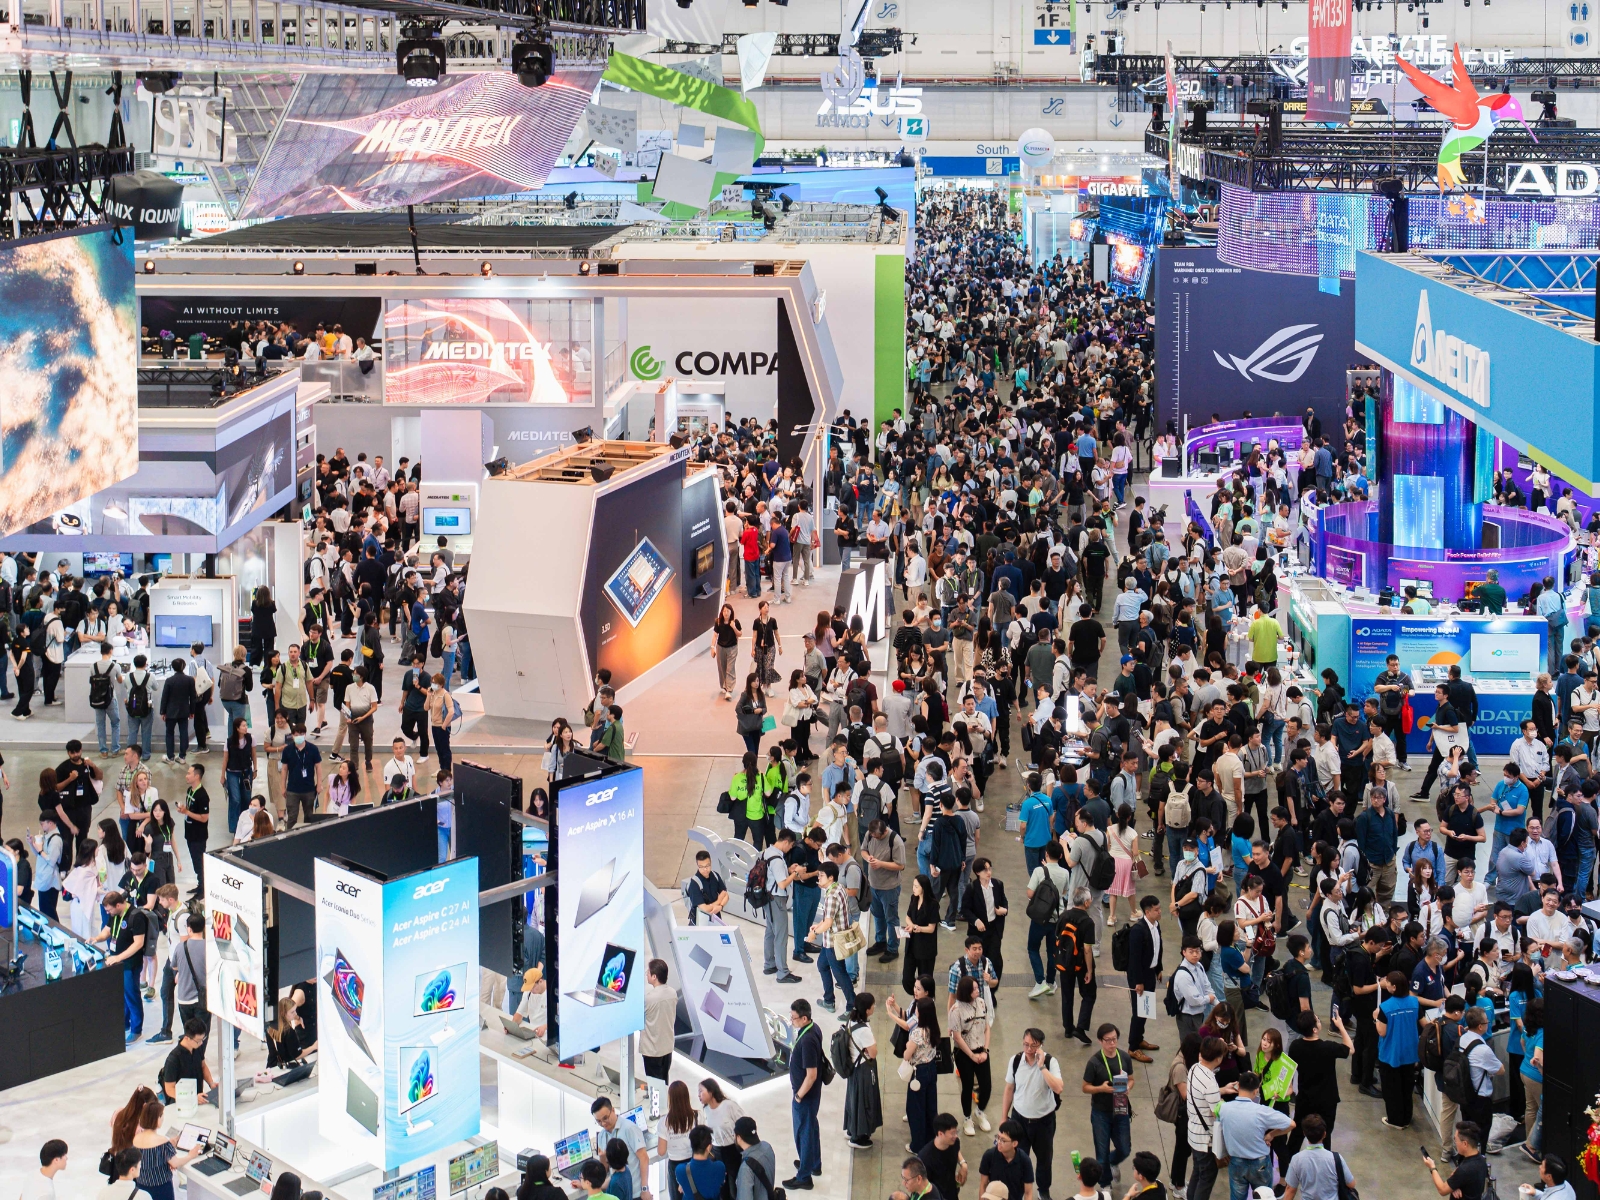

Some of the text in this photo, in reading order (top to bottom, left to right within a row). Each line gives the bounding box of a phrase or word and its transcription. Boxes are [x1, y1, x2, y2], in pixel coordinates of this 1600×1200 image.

[1037, 14, 1060, 28] 1F
[1290, 35, 1447, 59] GABYTE
[352, 115, 522, 154] MEDIATEK
[977, 144, 1010, 155] South
[1088, 181, 1150, 198] GIGABYTE
[183, 307, 280, 315] AI WITHOUT LIMITS
[423, 341, 554, 360] MEDIATEK
[1435, 329, 1491, 408] DELTA
[1401, 626, 1437, 634] Empowering
[1476, 710, 1533, 721] DATA
[1468, 725, 1523, 735] NDUSTRI
[585, 786, 619, 807] acer
[567, 808, 635, 837] Acer Aspire X 16 AI
[221, 874, 244, 891] acer
[336, 880, 362, 898] acer
[412, 877, 450, 900] acer
[321, 897, 333, 908] Acer
[333, 902, 349, 915] Iconia
[349, 909, 360, 920] Duo
[392, 900, 470, 933] Acer Aspire C 27 AI
[392, 915, 470, 948] Acer Aspire C 24 AI
[1412, 980, 1420, 990] 3
